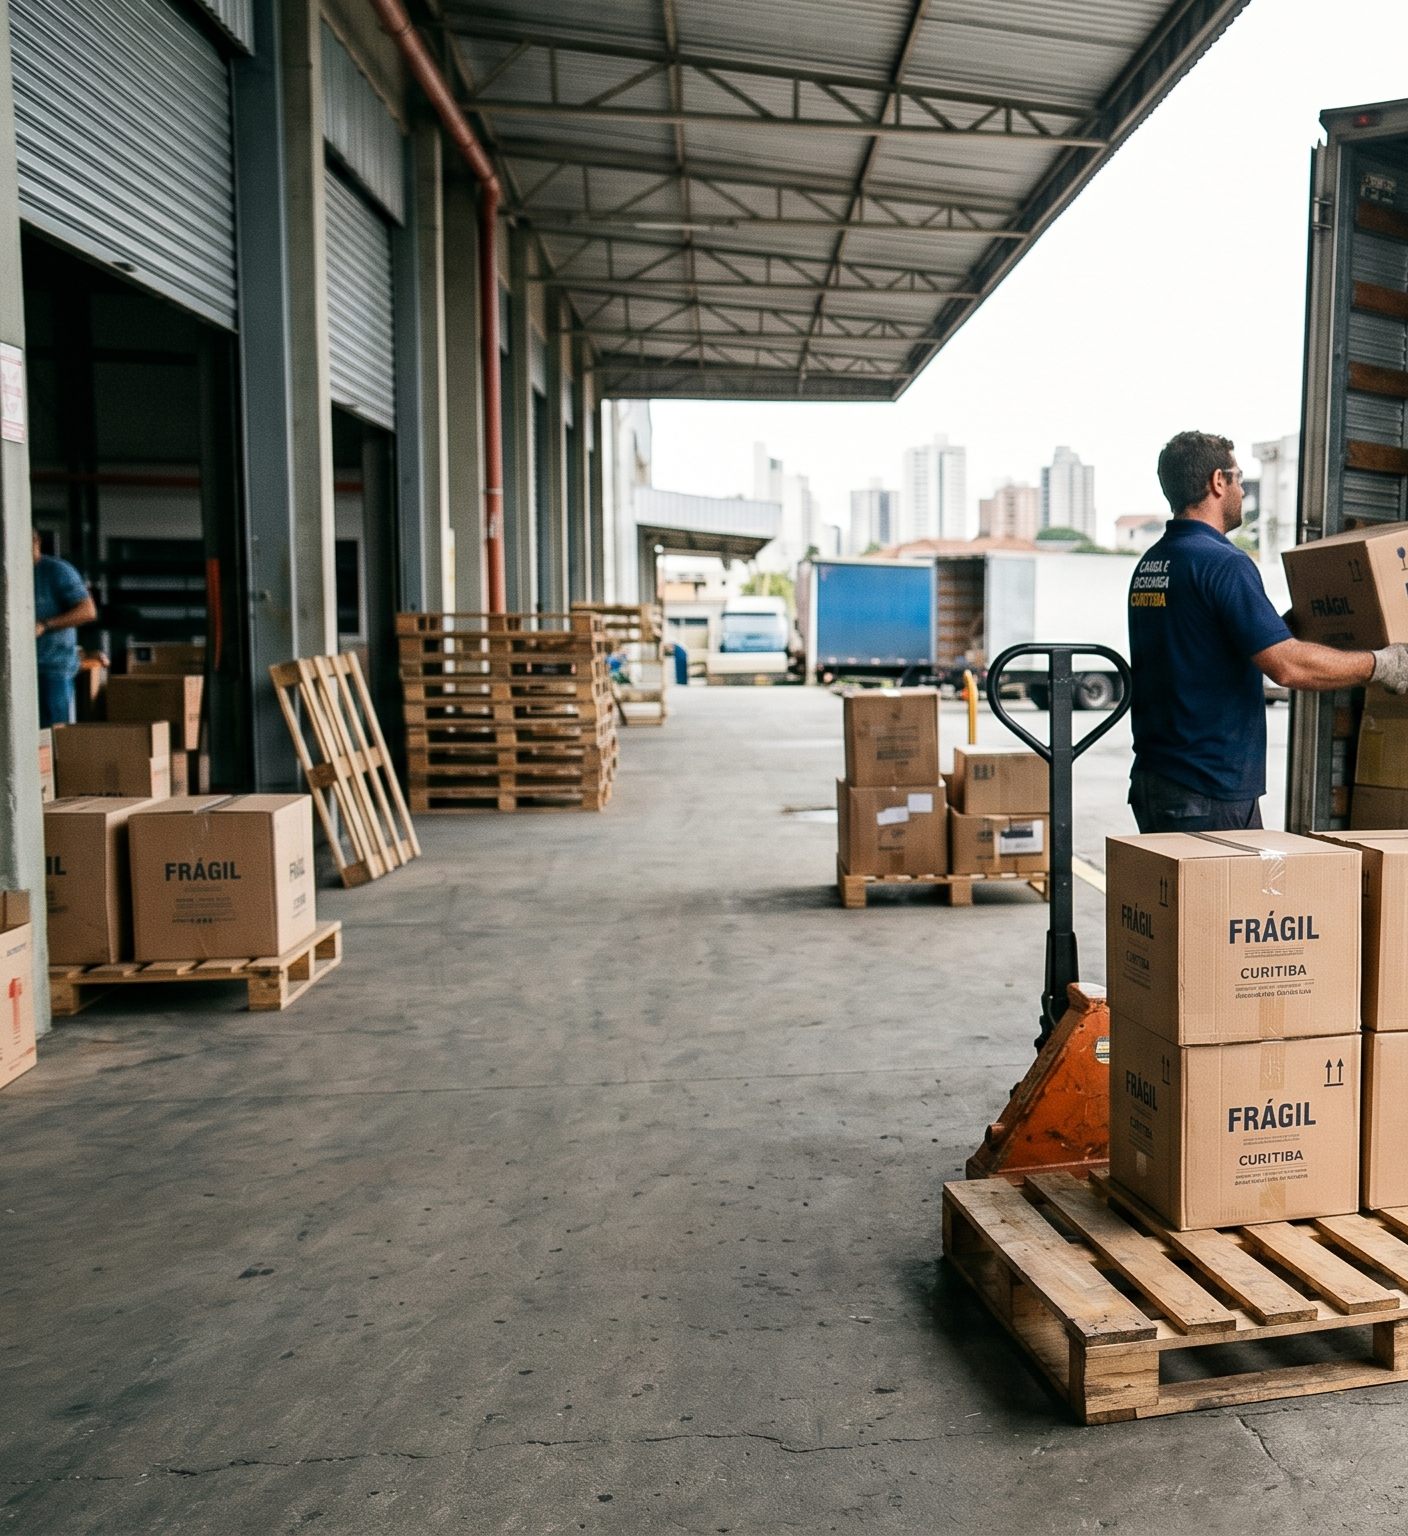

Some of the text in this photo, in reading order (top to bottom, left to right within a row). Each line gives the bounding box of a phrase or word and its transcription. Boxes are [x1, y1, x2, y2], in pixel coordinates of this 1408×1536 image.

[165, 857, 241, 881] FRÁGIL
[1121, 902, 1154, 940] FRÁGIL
[1229, 910, 1320, 944] FRÁGIL
[1240, 964, 1307, 979] CURITIBA
[1125, 1069, 1158, 1112] FRÁGIL
[1228, 1098, 1316, 1133] FRÁGIL
[1238, 1150, 1304, 1166] CURITIBA
